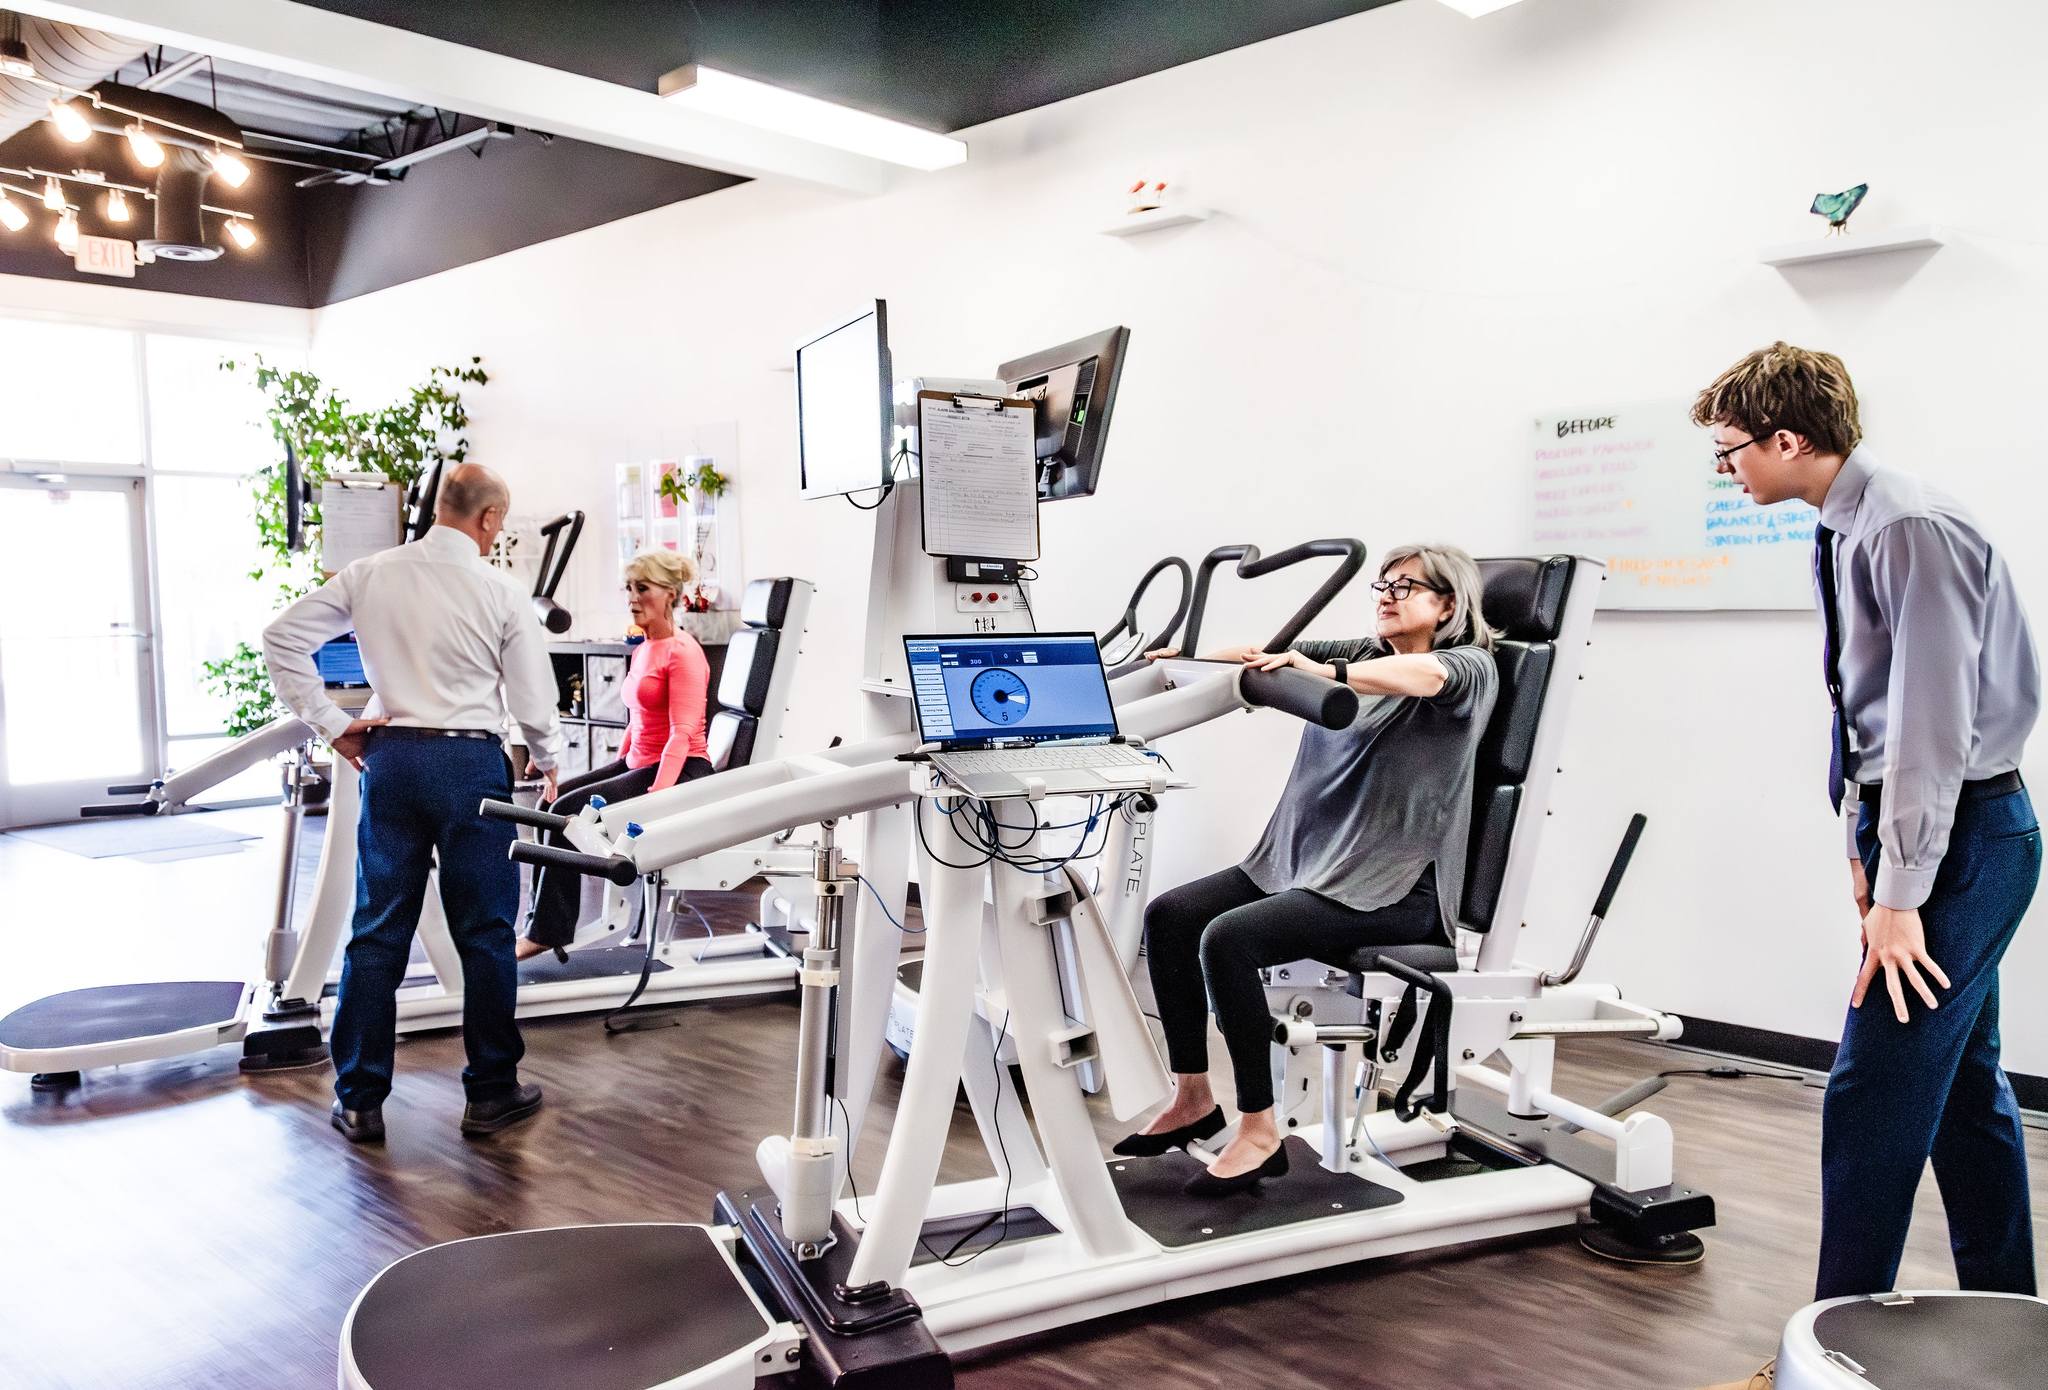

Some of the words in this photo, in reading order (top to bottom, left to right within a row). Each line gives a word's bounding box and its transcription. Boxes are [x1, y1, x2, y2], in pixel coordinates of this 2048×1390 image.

[88, 239, 127, 268] EXIT
[1557, 416, 1618, 438] BEFORE
[1002, 711, 1009, 722] 5
[1126, 822, 1147, 894] PLATE
